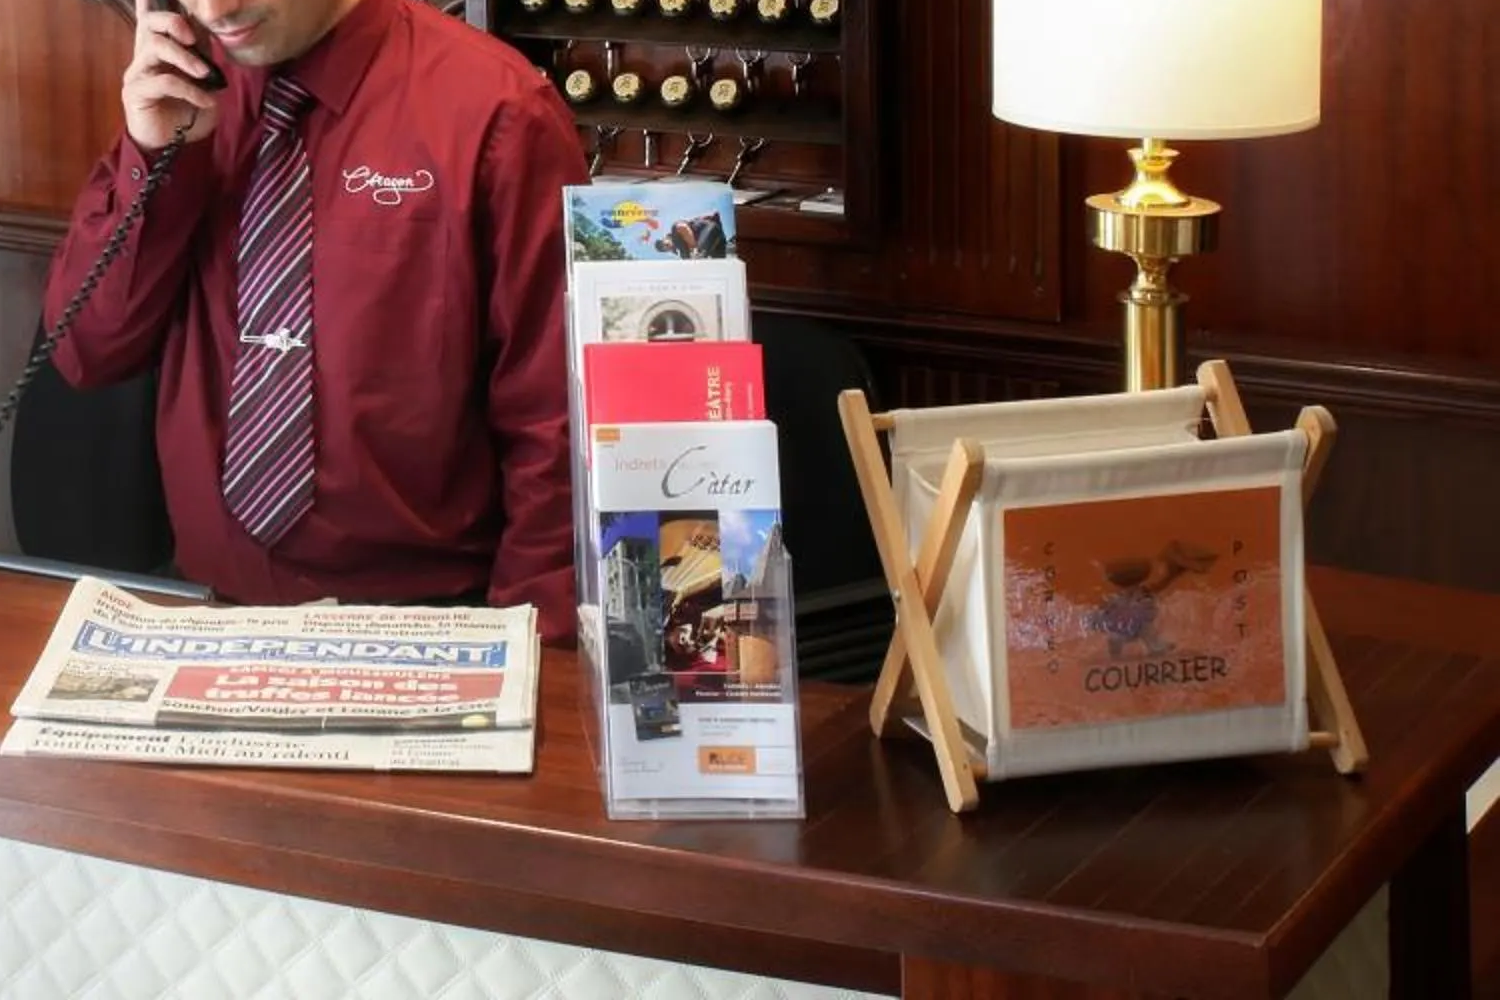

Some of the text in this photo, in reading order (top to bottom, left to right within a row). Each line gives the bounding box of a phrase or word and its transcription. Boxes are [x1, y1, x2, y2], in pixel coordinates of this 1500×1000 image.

[215, 673, 458, 691] La saison des
[1084, 656, 1228, 693] COURRIER
[205, 686, 331, 701] truffes
